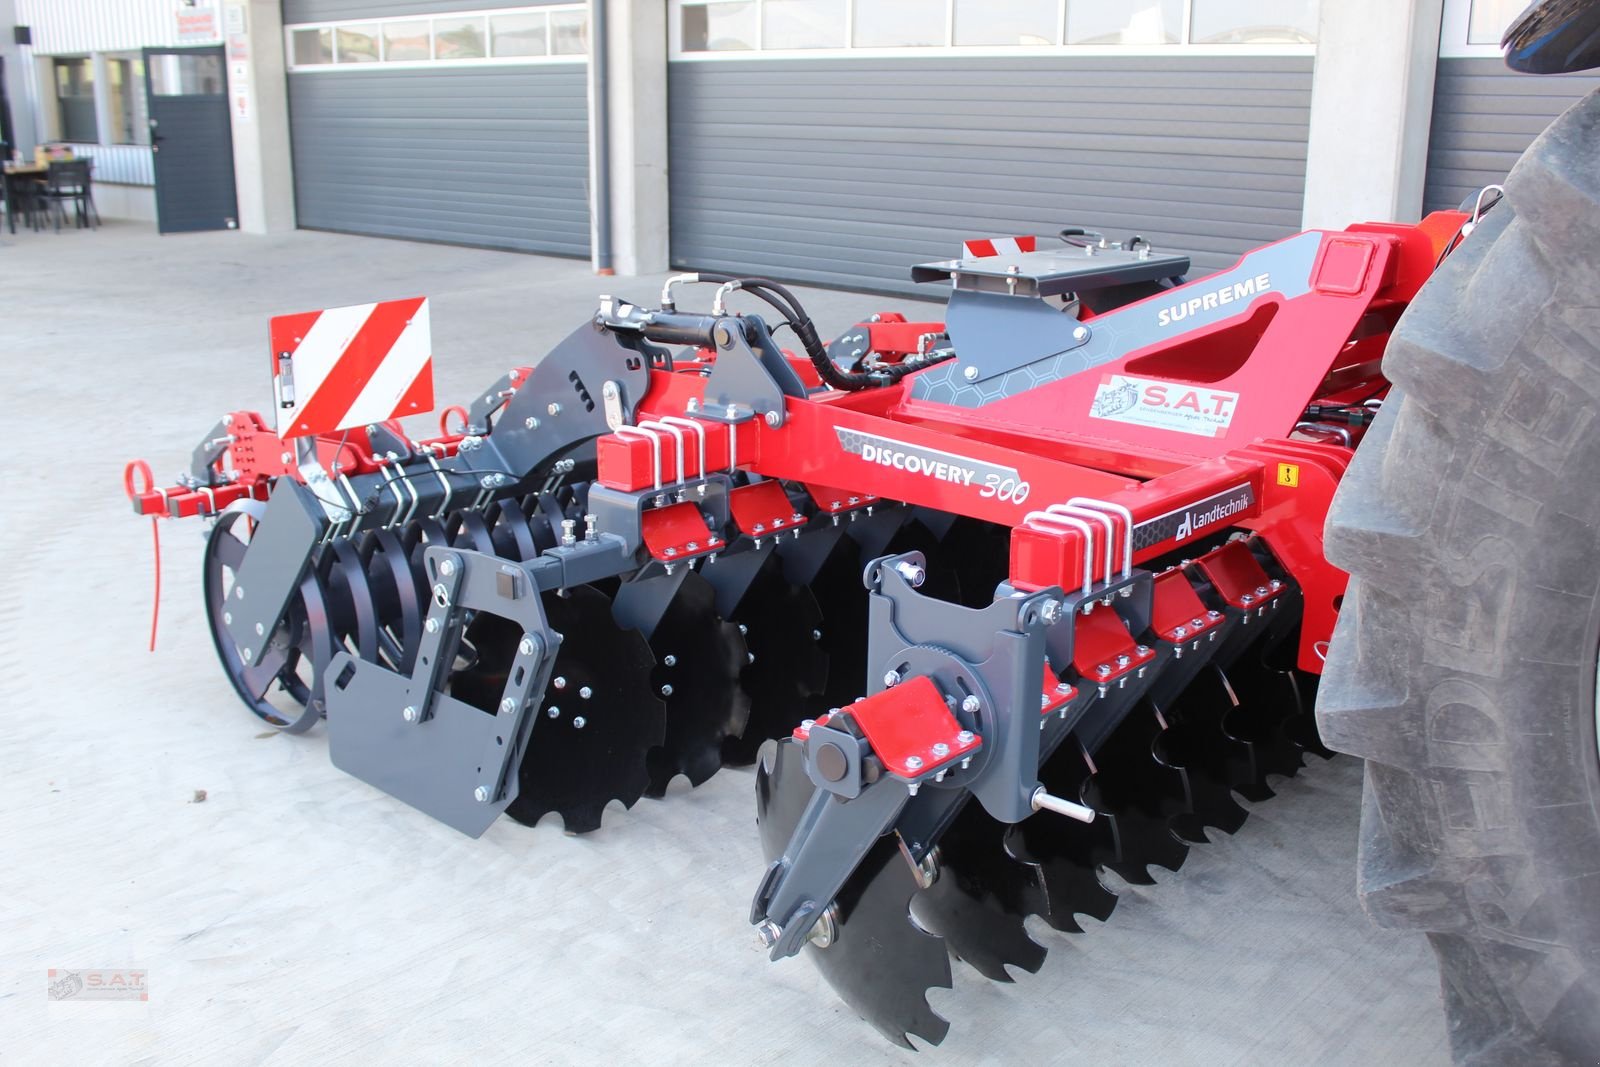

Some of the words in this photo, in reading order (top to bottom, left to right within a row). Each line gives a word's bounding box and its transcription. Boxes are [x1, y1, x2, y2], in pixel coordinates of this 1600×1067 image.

[1158, 273, 1271, 327] SUPREME
[1142, 385, 1234, 417] S.A.T.
[862, 444, 975, 486] DISCOVERY
[979, 473, 1030, 505] 300
[1193, 494, 1249, 529] Landtechnik
